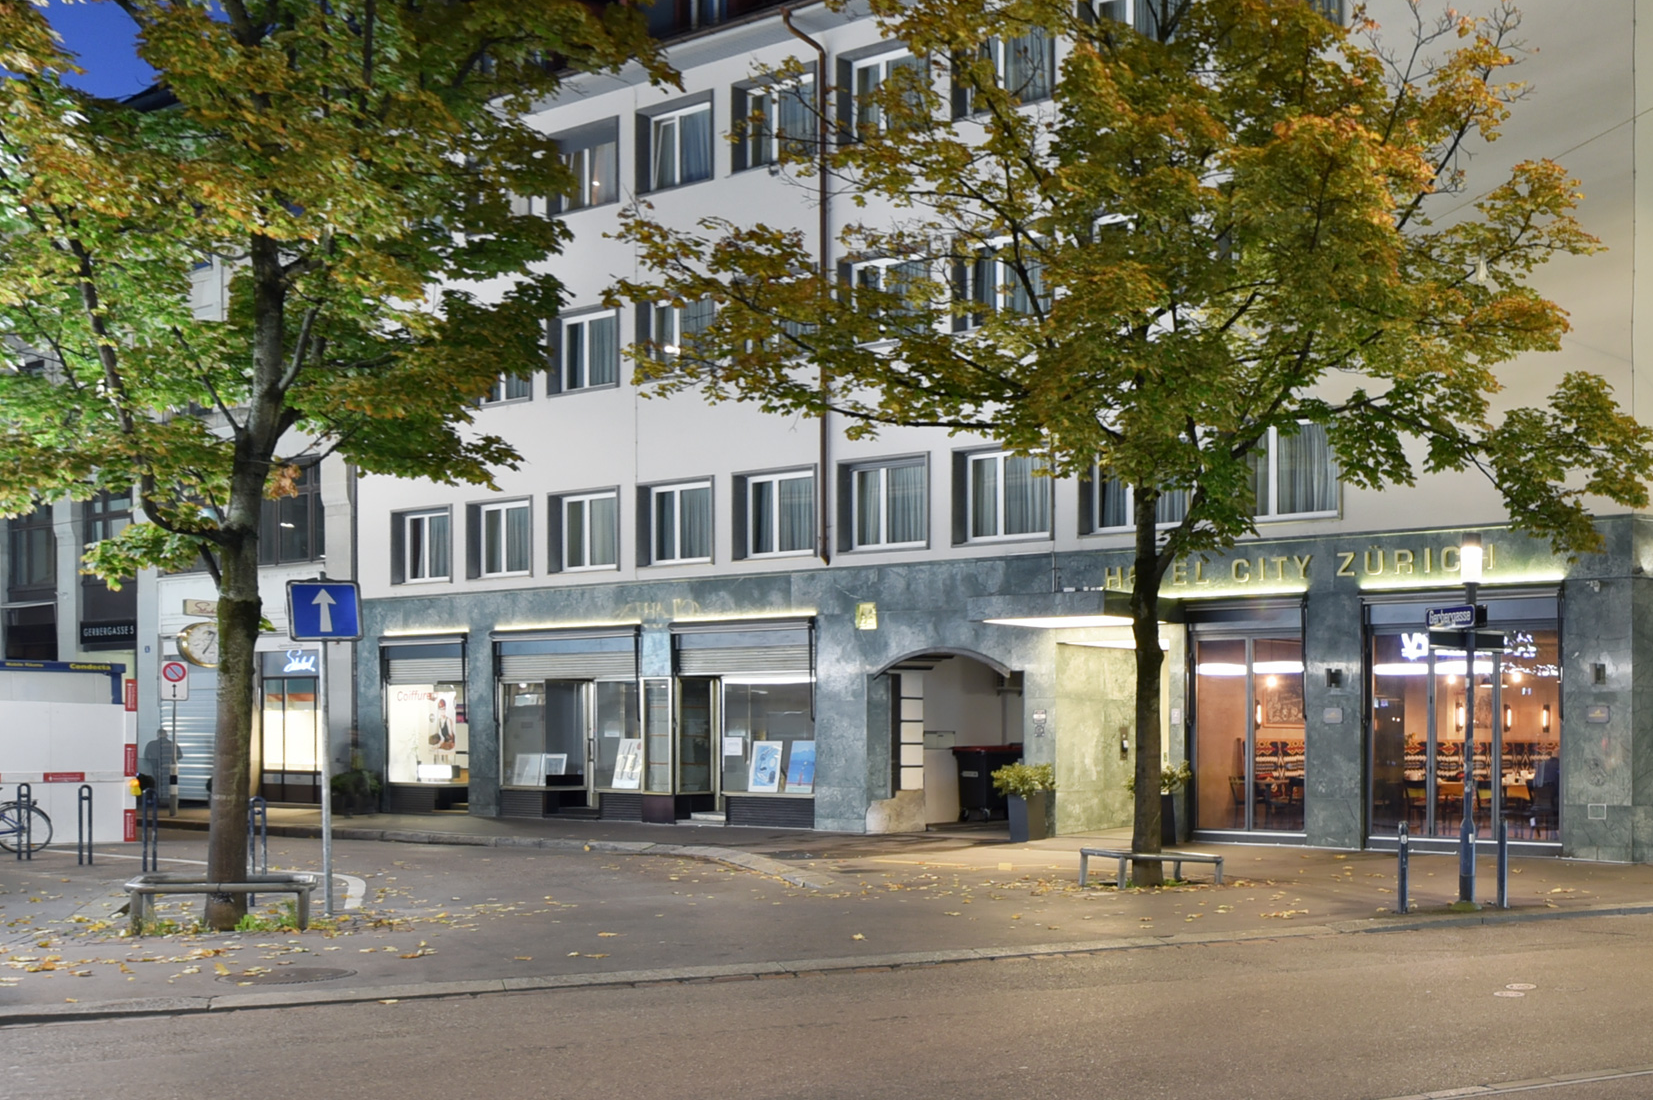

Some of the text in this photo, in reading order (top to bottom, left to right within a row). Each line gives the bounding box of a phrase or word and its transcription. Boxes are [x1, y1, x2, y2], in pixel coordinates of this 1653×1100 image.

[1104, 561, 1210, 589] HEL
[1231, 554, 1314, 583] CITY
[1428, 609, 1471, 626] Gerbergasse
[83, 625, 134, 637] GERBERGASSE 5
[69, 663, 111, 671] Condecta
